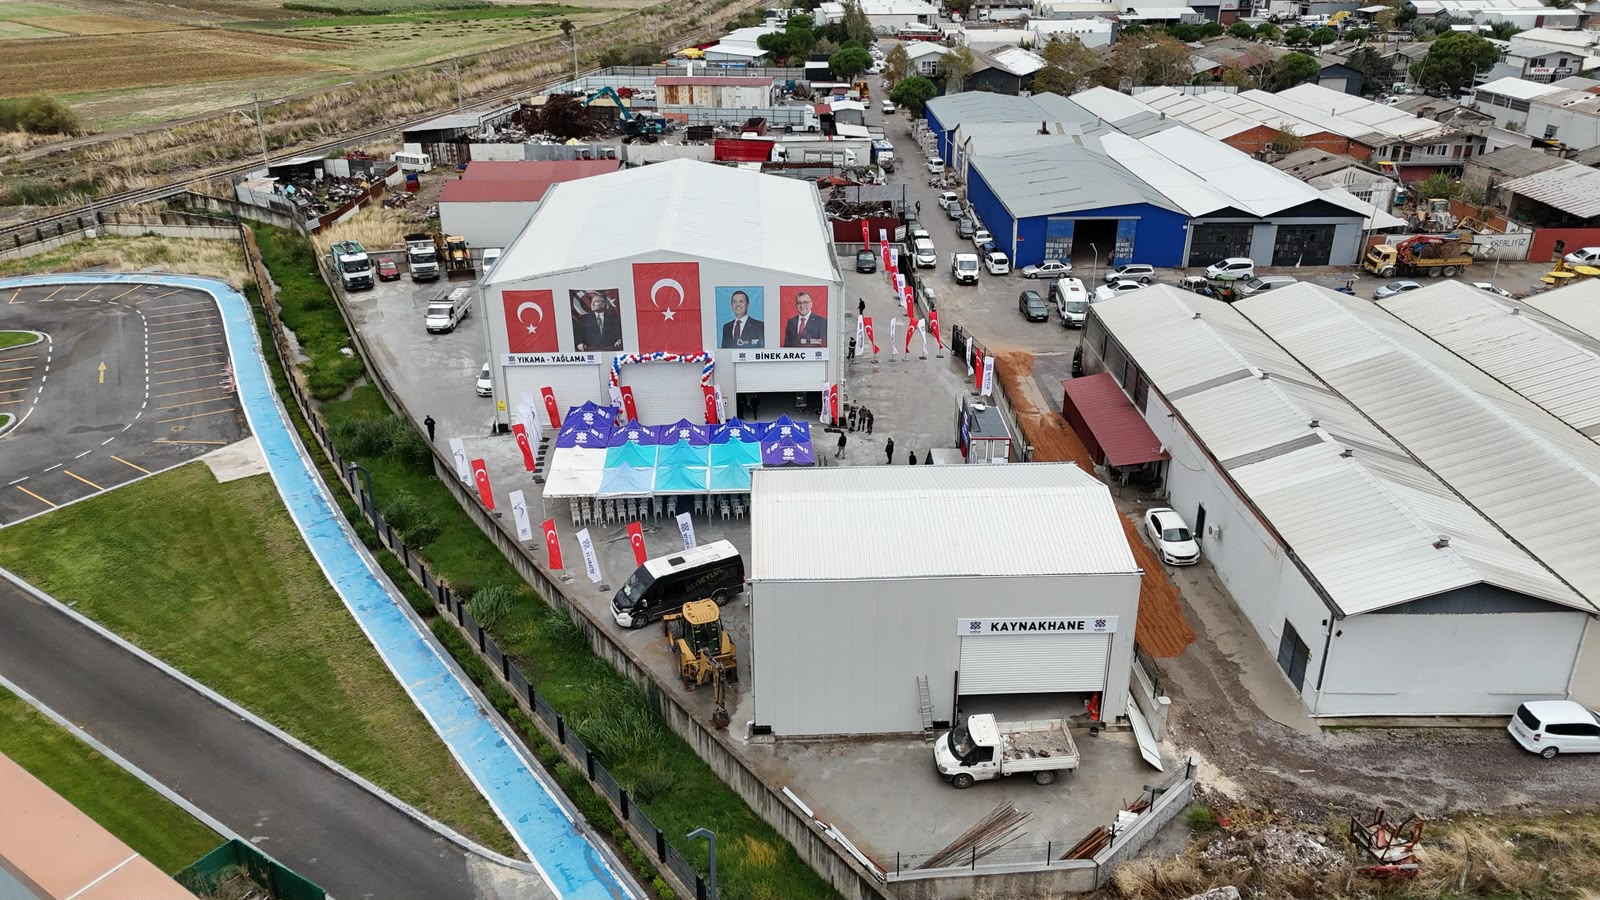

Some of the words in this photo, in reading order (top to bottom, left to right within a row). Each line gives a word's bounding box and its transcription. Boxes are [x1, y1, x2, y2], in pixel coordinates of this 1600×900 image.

[517, 356, 546, 364] YIKAMA
[552, 353, 586, 363] YAĞLAMA
[755, 352, 781, 360] BİNEK
[783, 352, 806, 360] ARAÇ
[990, 620, 1086, 632] KAYNAKHANE
